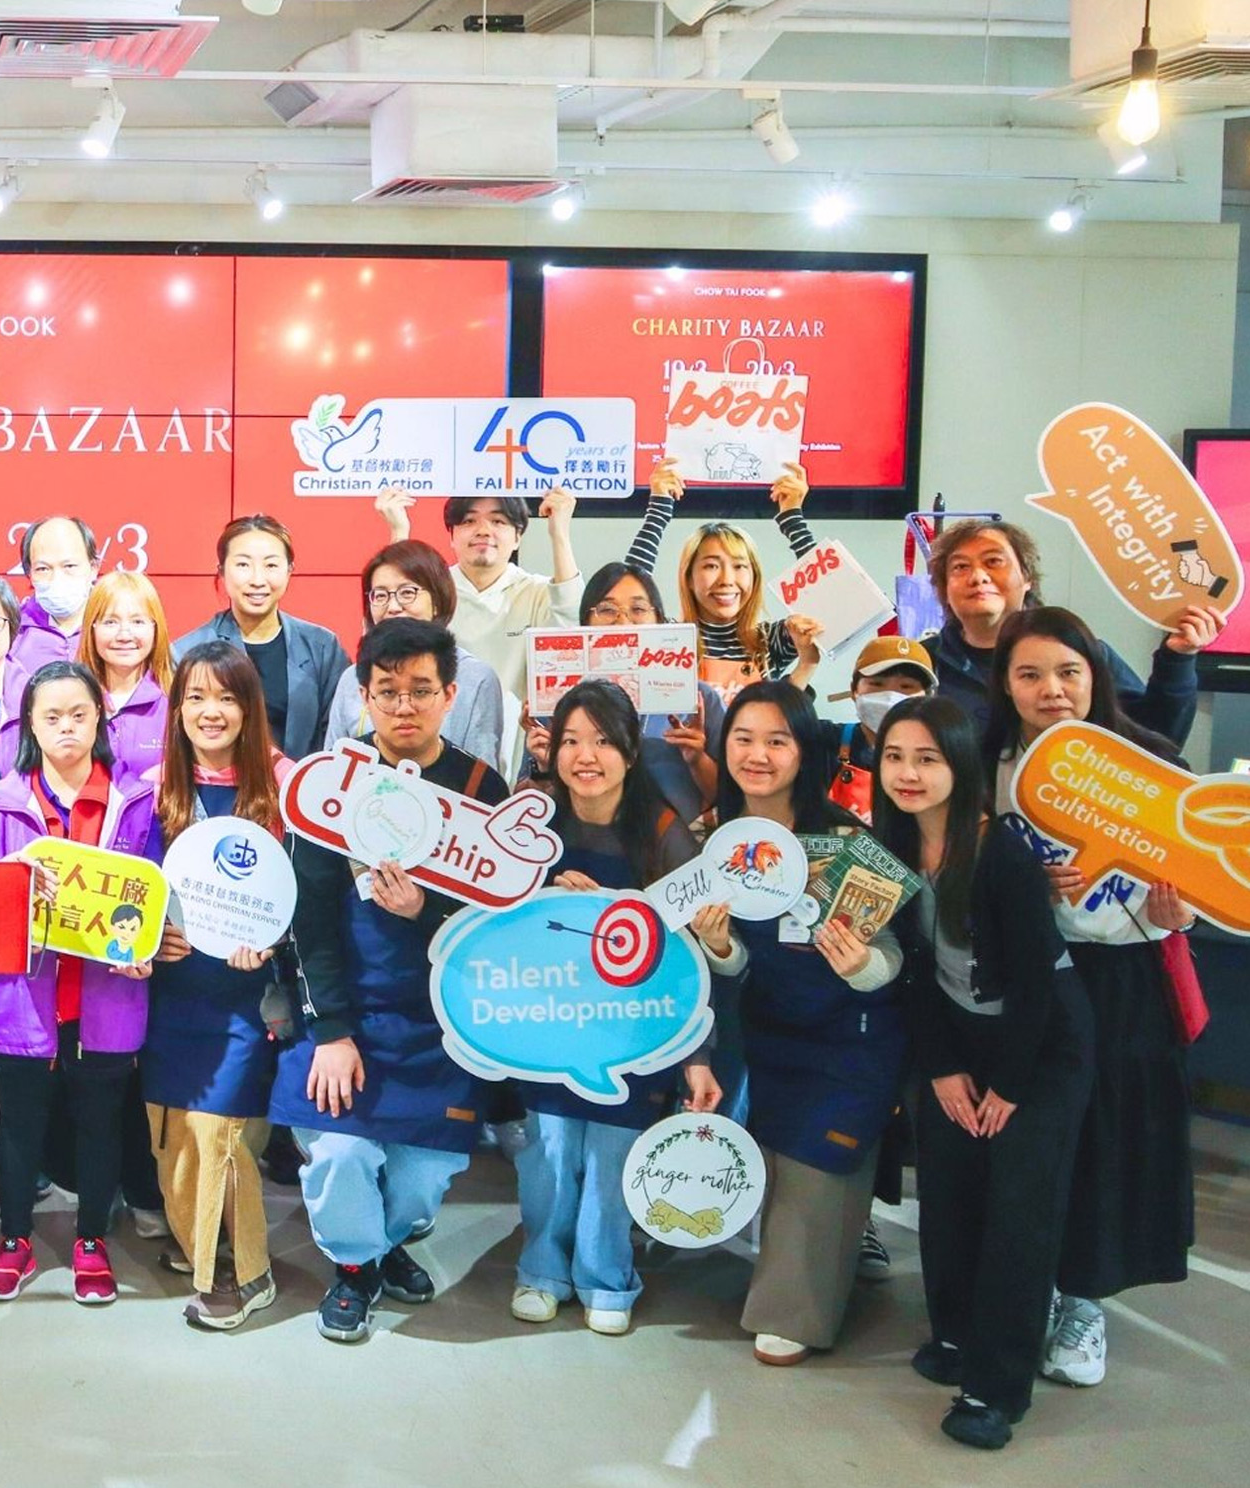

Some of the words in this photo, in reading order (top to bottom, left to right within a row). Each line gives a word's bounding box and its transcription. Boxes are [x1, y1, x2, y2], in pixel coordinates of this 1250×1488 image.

[694, 287, 723, 296] CHOW
[632, 318, 731, 336] CHARITY
[740, 320, 826, 337] BAZAAR
[668, 378, 807, 431] boats
[564, 443, 606, 459] years
[609, 442, 627, 457] of
[564, 459, 626, 474] 擇善勵行
[298, 476, 372, 491] Christian
[376, 477, 434, 491] Action
[475, 477, 528, 490] FAITH
[534, 477, 554, 490] IN
[561, 477, 627, 491] ACTION
[1078, 424, 1129, 474] Act
[1122, 475, 1179, 539] with
[1086, 483, 1184, 602] Integrity
[638, 647, 695, 669] boats
[1064, 738, 1162, 800] Chinese
[1049, 761, 1140, 819] Culture
[1036, 783, 1168, 864] Cultivation
[665, 869, 711, 913] Still
[469, 956, 580, 990] Talent
[472, 994, 676, 1028] Development
[631, 1161, 692, 1195] ginger
[701, 1165, 755, 1195] mother
